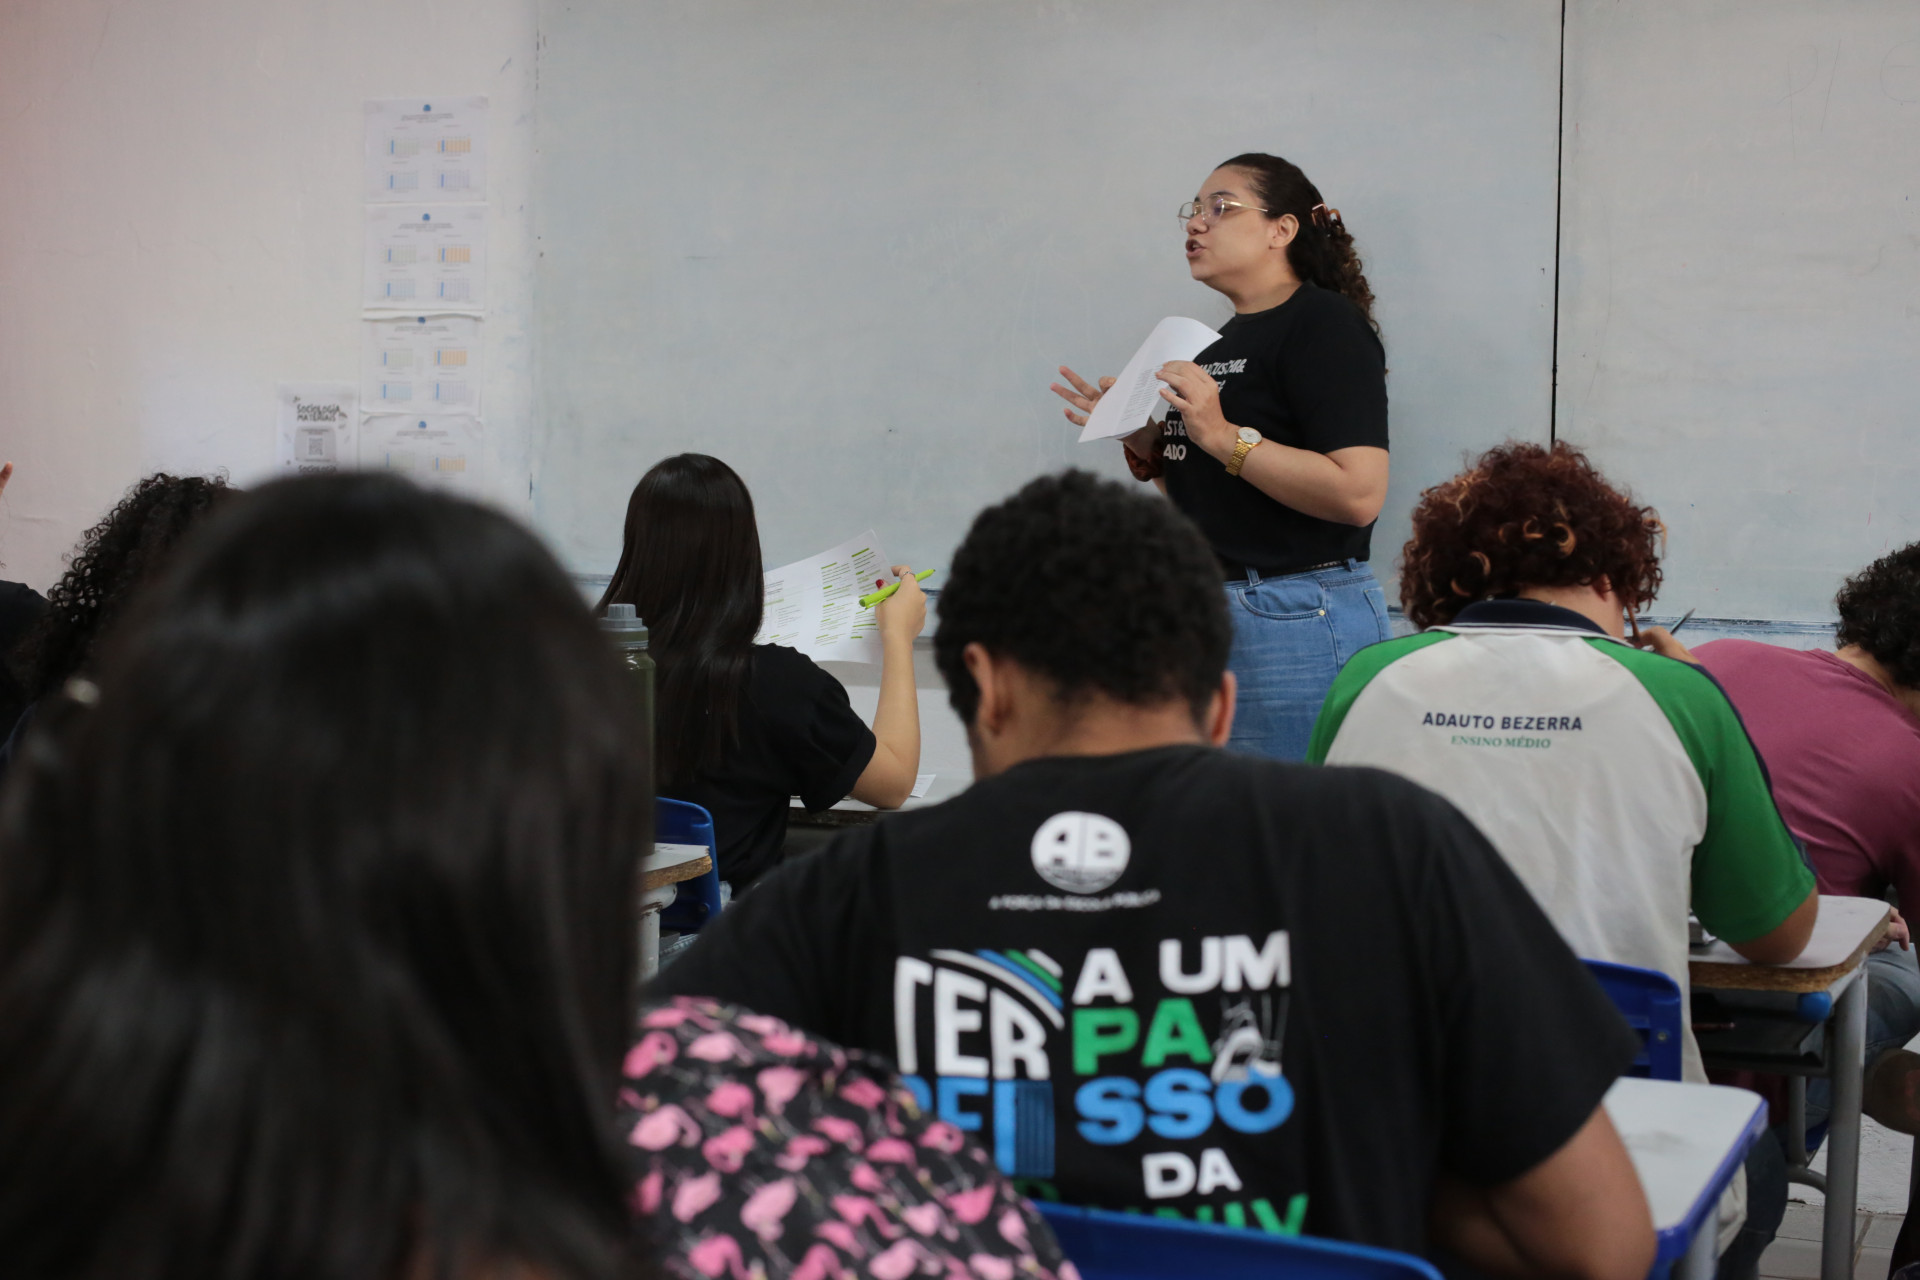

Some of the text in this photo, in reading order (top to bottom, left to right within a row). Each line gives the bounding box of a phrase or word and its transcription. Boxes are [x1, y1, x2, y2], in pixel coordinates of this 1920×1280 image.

[1423, 712, 1583, 731] ADAUTO BEZERRA
[1451, 735, 1552, 748] ENSINO MÉDIO
[1072, 930, 1291, 1005] A UM
[1074, 1067, 1295, 1145] SSO
[1142, 1147, 1243, 1199] DA
